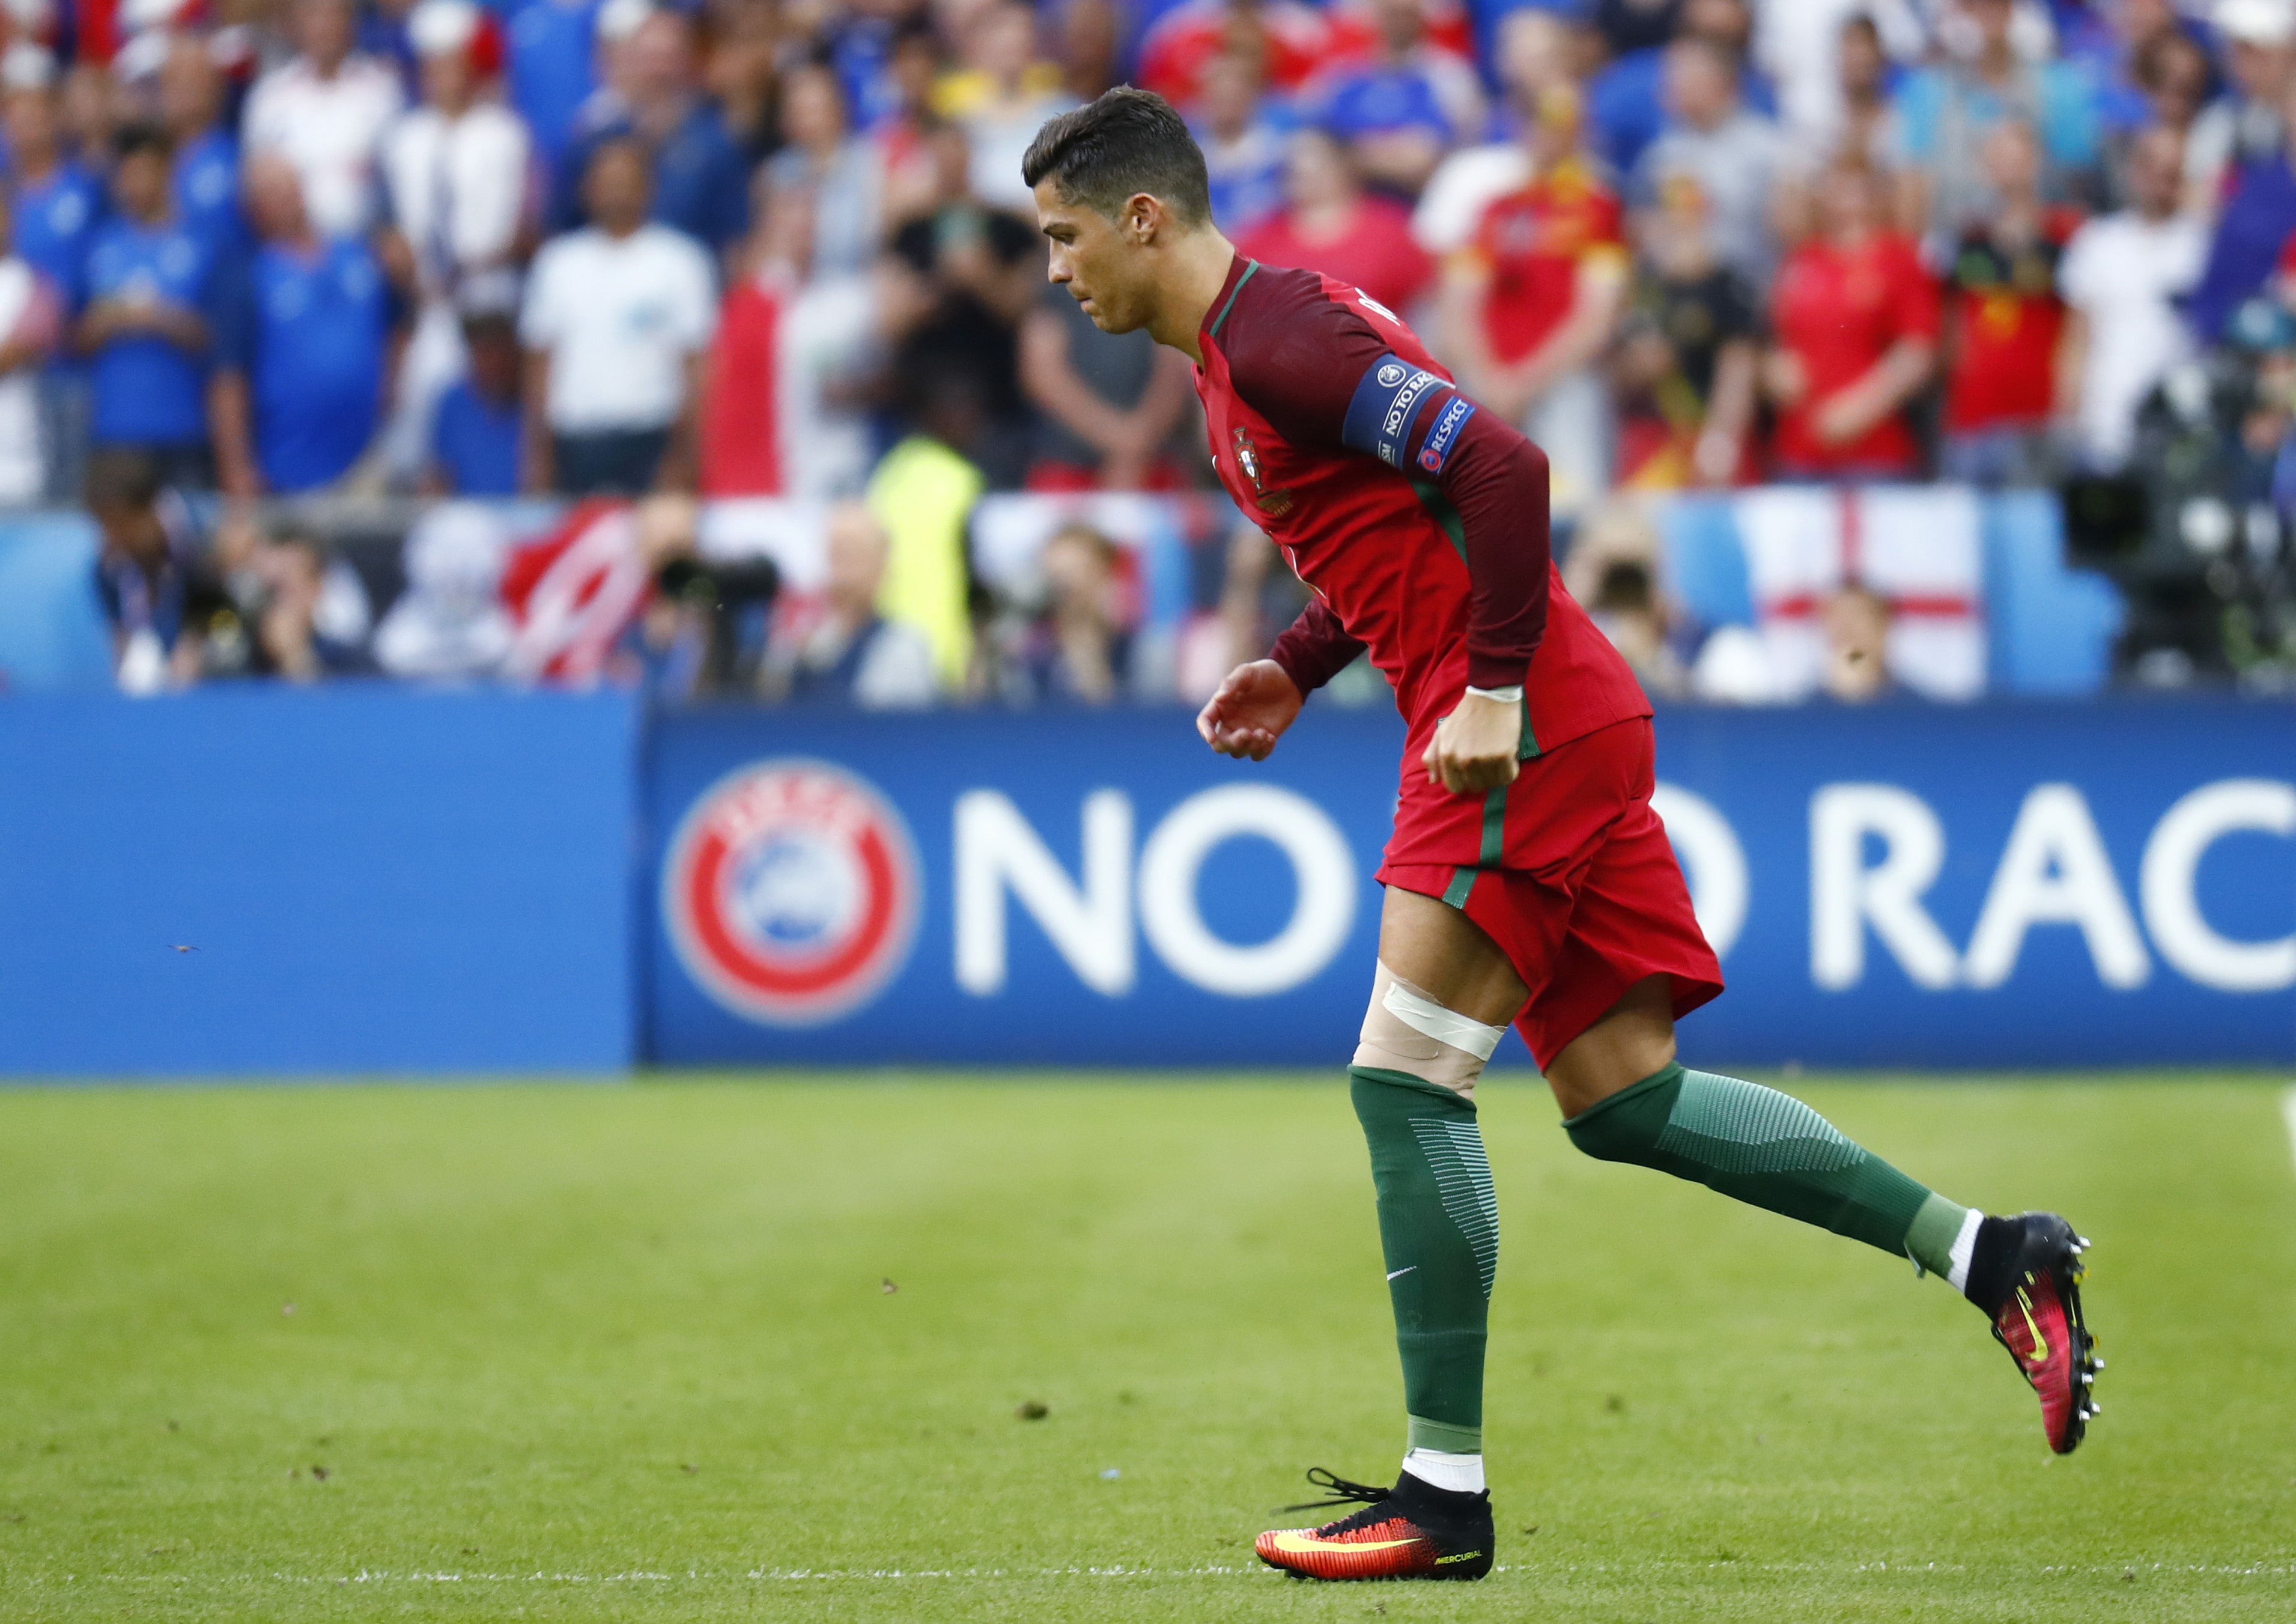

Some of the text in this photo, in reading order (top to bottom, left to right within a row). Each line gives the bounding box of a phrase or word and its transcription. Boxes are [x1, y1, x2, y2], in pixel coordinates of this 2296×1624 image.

[1386, 410, 1401, 436] NO
[1396, 389, 1413, 409] TO
[1431, 399, 1468, 451] RESPECT
[954, 787, 1356, 998] NO
[1810, 779, 2296, 993] RAC
[1434, 1549, 1483, 1565] MERCURIAL
